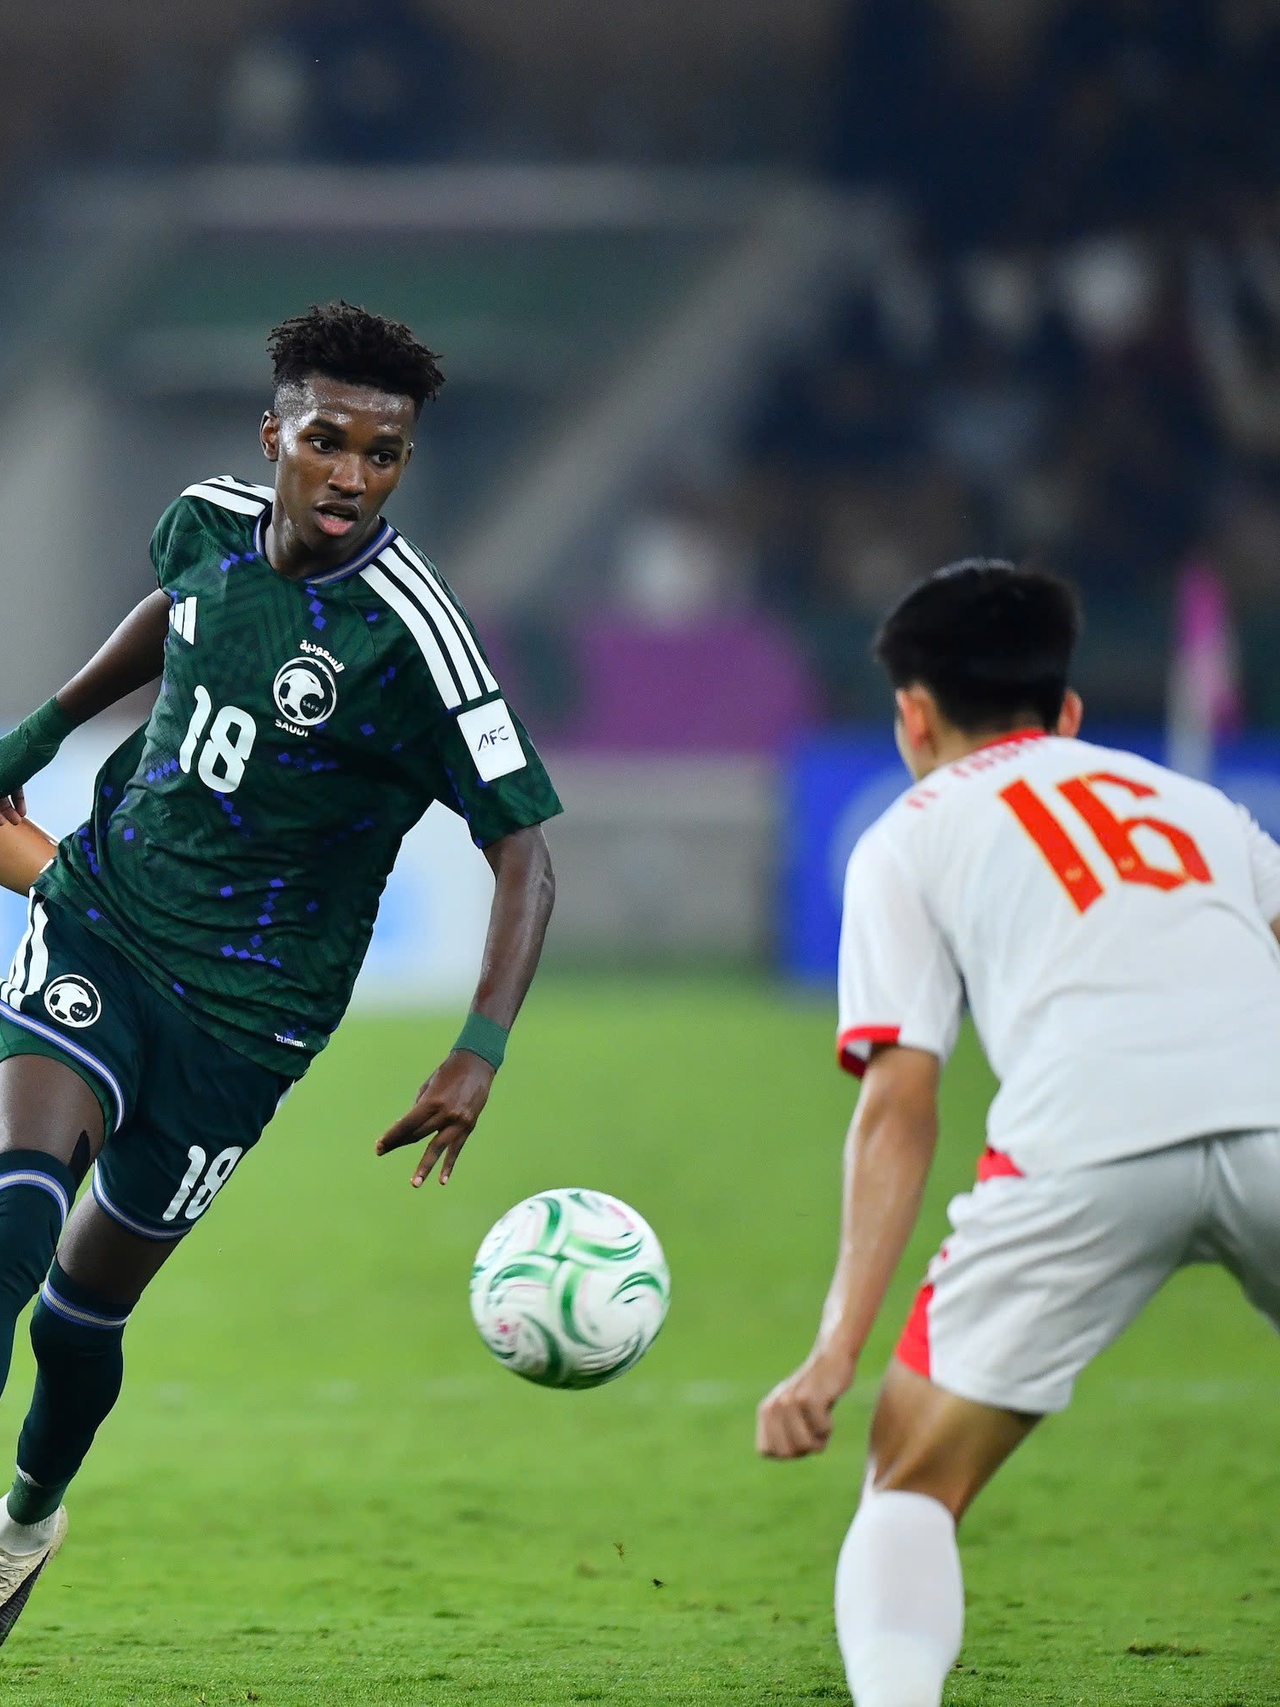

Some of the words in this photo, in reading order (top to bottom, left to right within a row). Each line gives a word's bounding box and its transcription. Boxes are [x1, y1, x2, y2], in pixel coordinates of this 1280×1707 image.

[300, 639, 345, 673] السعودية
[302, 700, 320, 712] SAFF
[179, 685, 257, 793] 18
[274, 719, 309, 737] SAUDI
[478, 725, 509, 751] AFC
[999, 771, 1214, 915] 16
[163, 1145, 243, 1221] 18
